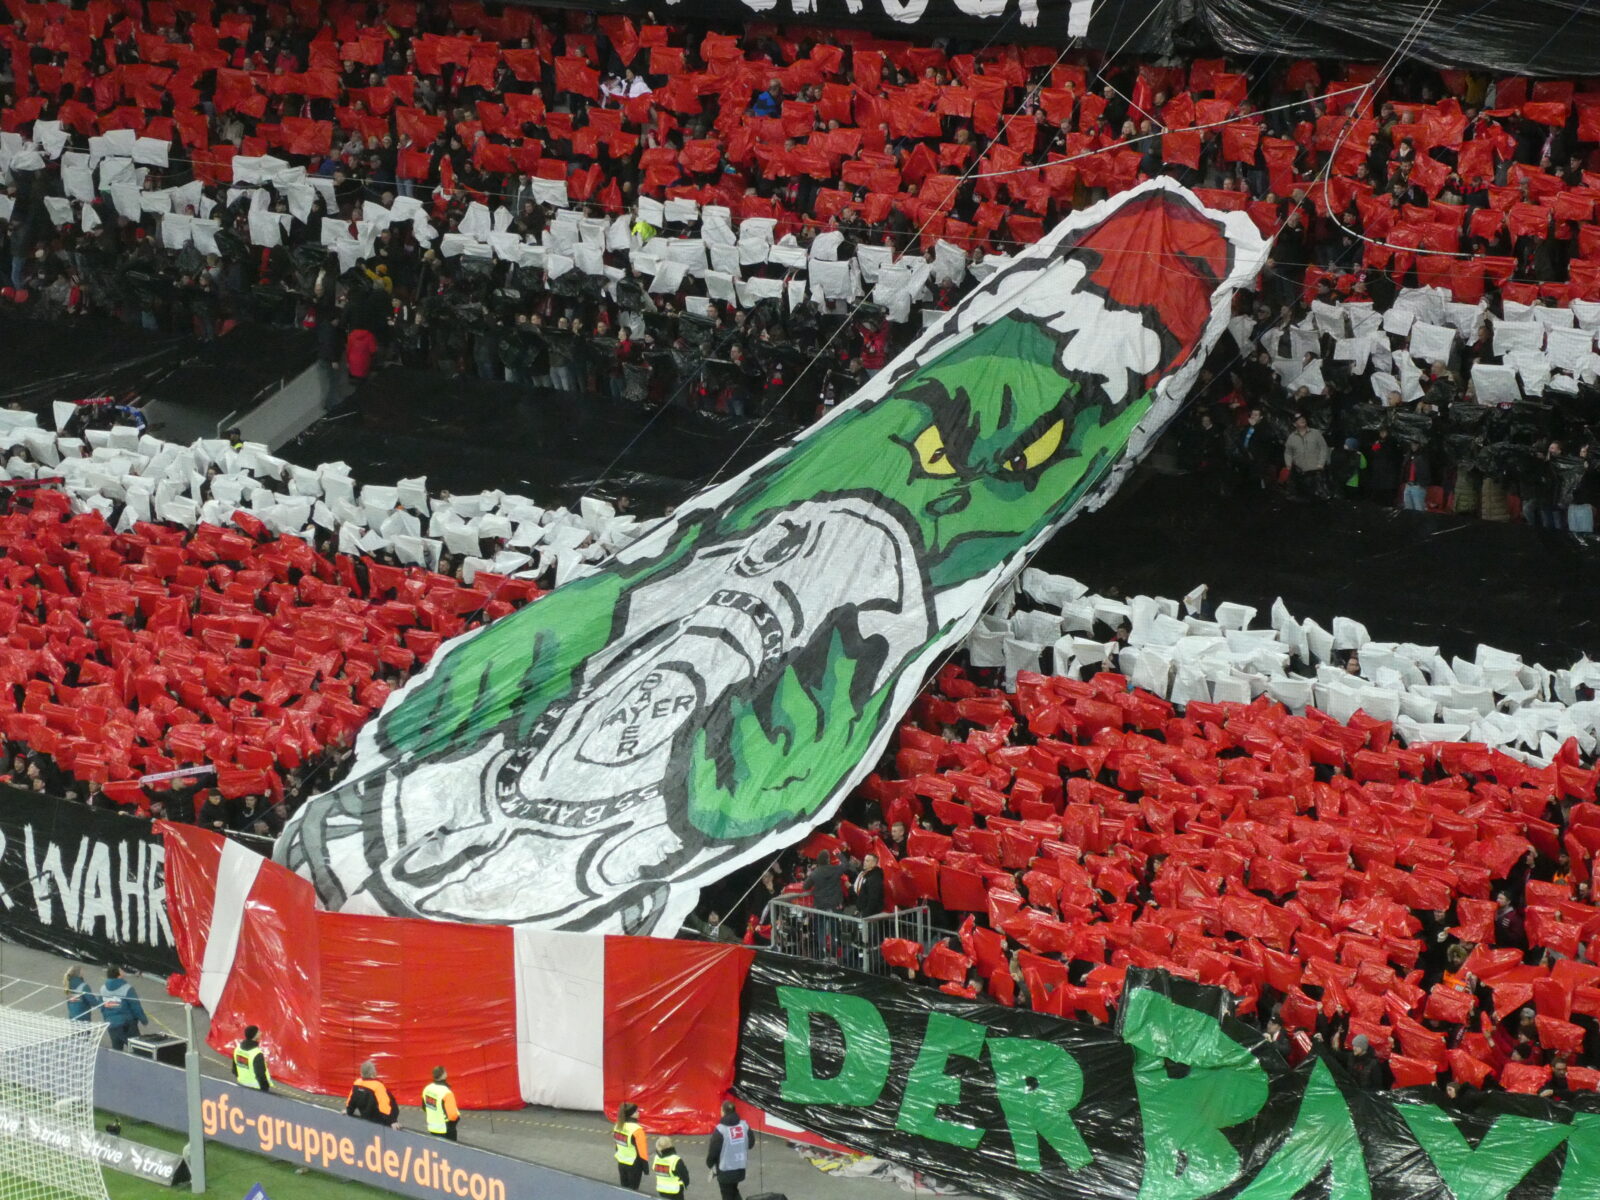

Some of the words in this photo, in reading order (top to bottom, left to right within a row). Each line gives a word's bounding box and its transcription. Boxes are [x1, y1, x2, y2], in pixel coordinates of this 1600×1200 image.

[776, 985, 1094, 1173] DER
[93, 1141, 123, 1164] trive
[143, 1155, 174, 1178] trive
[202, 1093, 506, 1200] gfc-gruppe.de/ditcon
